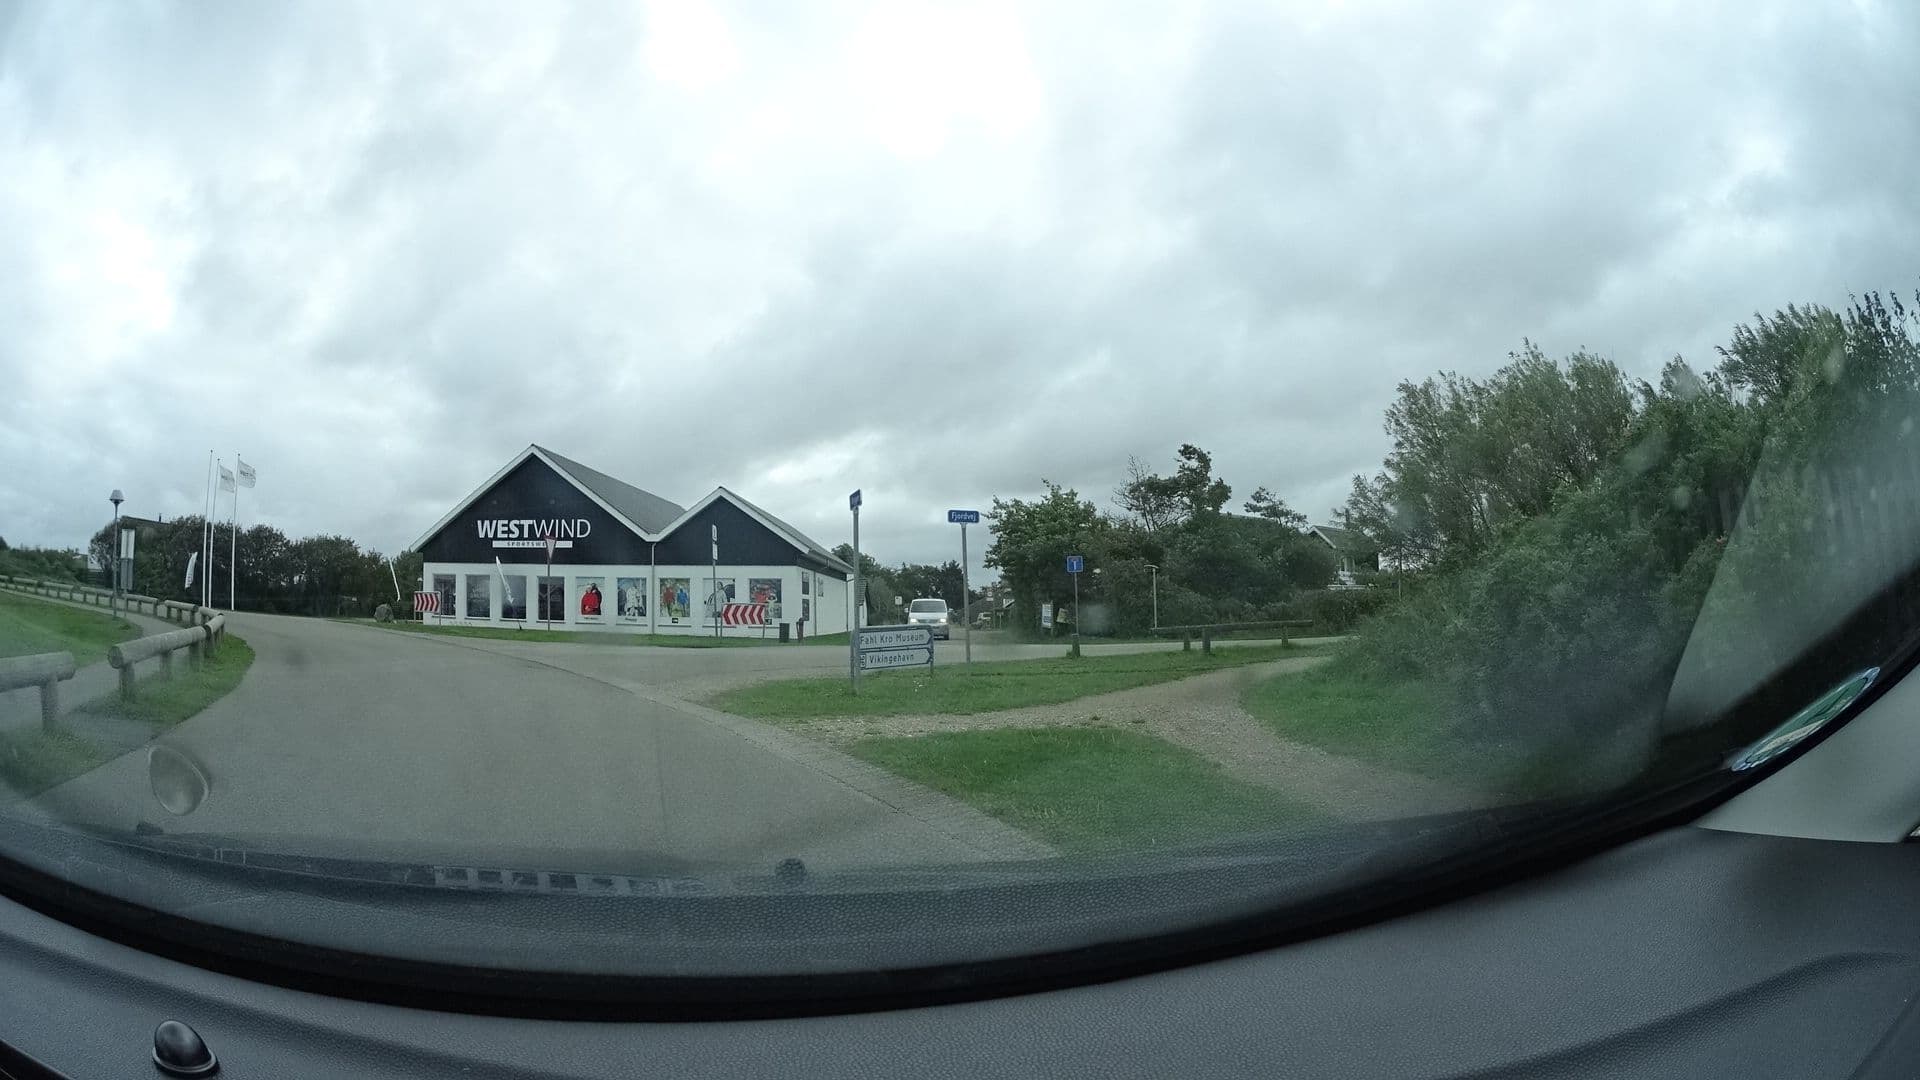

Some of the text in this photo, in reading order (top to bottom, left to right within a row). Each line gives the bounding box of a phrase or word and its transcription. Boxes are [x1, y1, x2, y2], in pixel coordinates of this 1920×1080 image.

[951, 511, 977, 522] Fjordvej
[477, 519, 591, 538] WESTWIND
[880, 633, 893, 643] Kro
[896, 631, 925, 642] Museum
[869, 653, 915, 664] Vikingehavn
